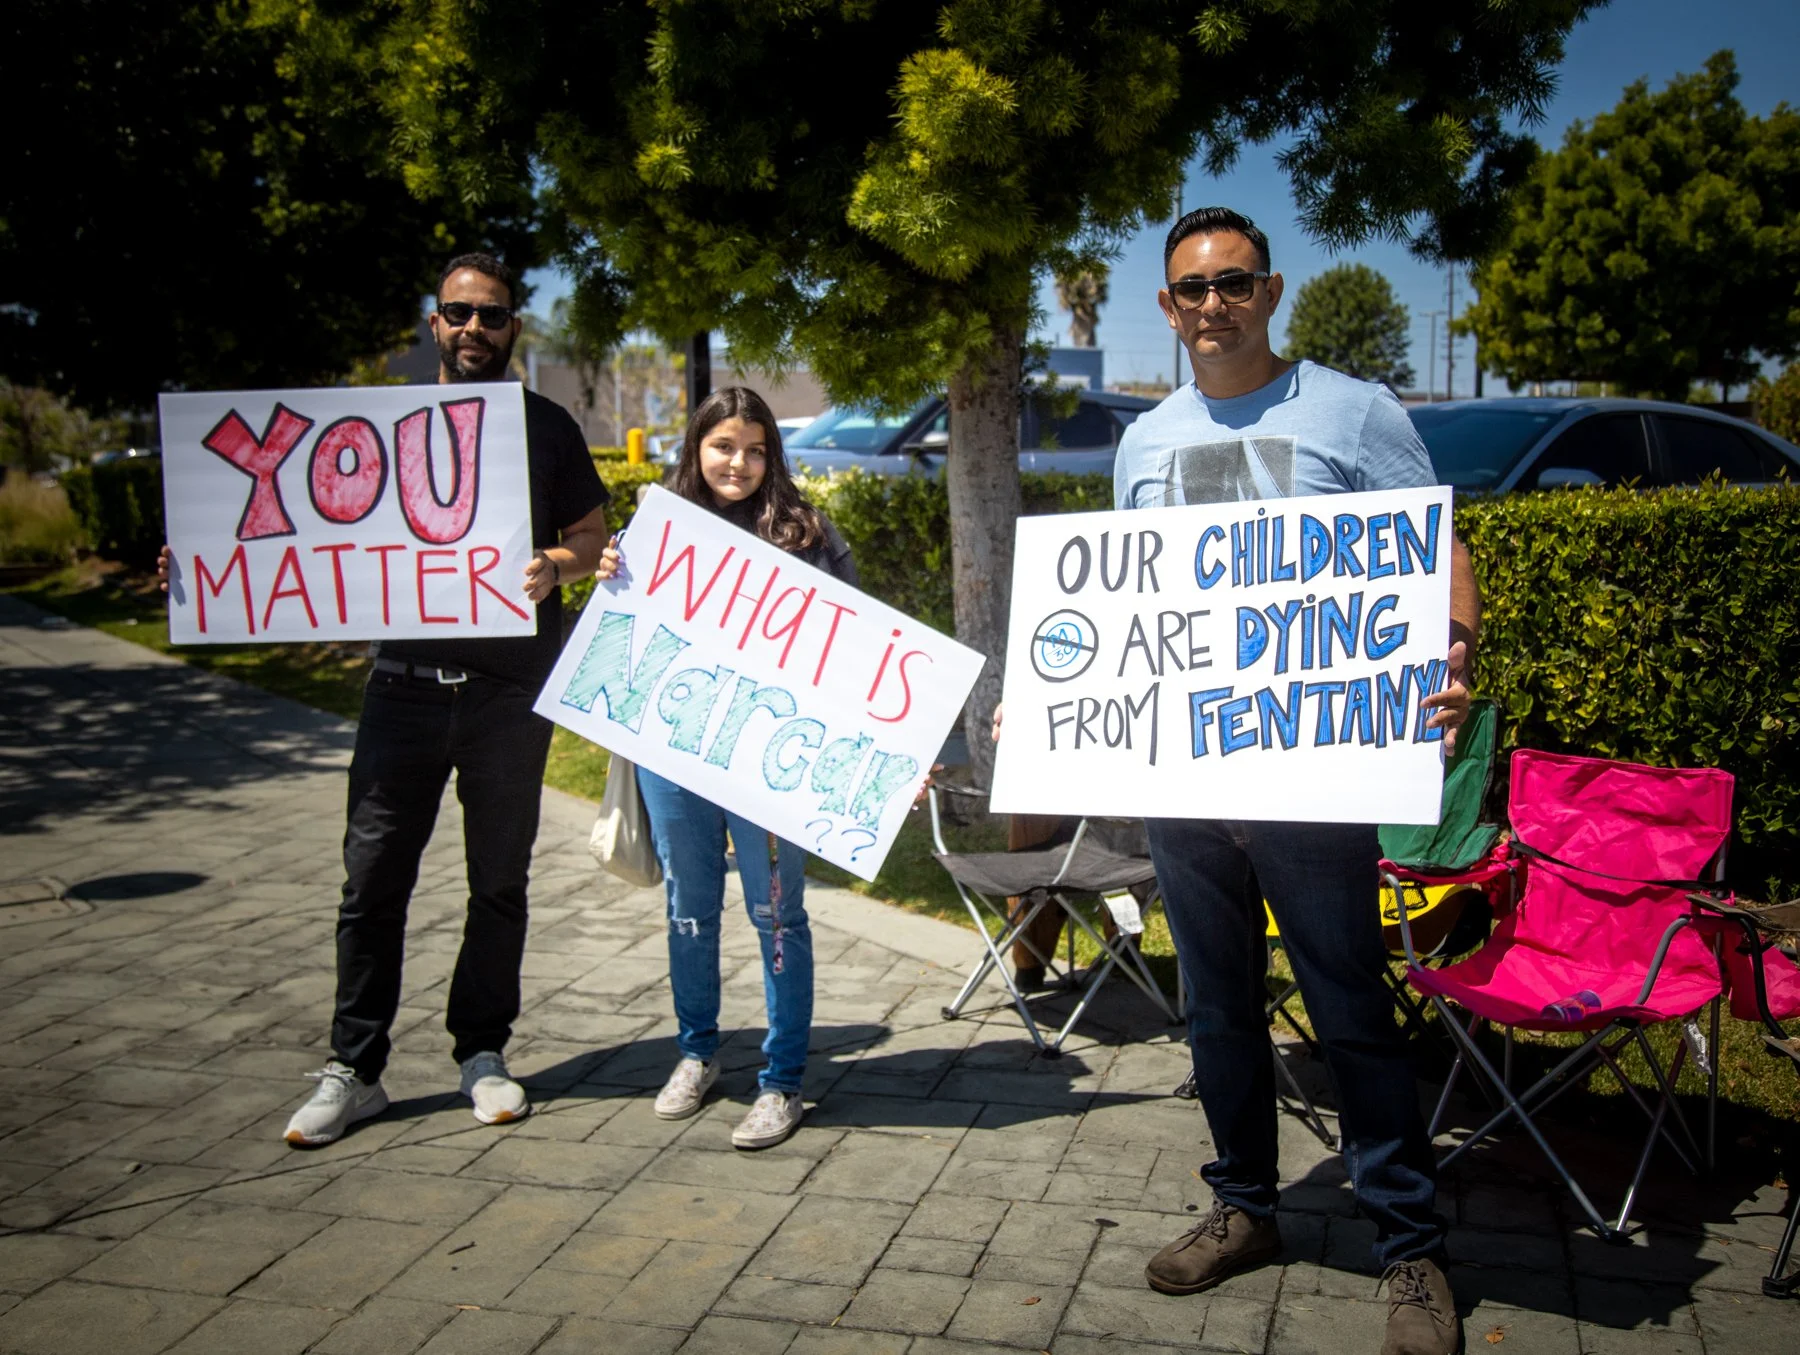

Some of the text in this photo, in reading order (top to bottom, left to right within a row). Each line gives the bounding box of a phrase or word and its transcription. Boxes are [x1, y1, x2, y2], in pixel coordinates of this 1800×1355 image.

[202, 396, 485, 545] YOU
[194, 542, 531, 636] MATTER
[1056, 530, 1163, 595] OUR
[1117, 609, 1213, 677] ARE
[1047, 682, 1160, 766] FROM
